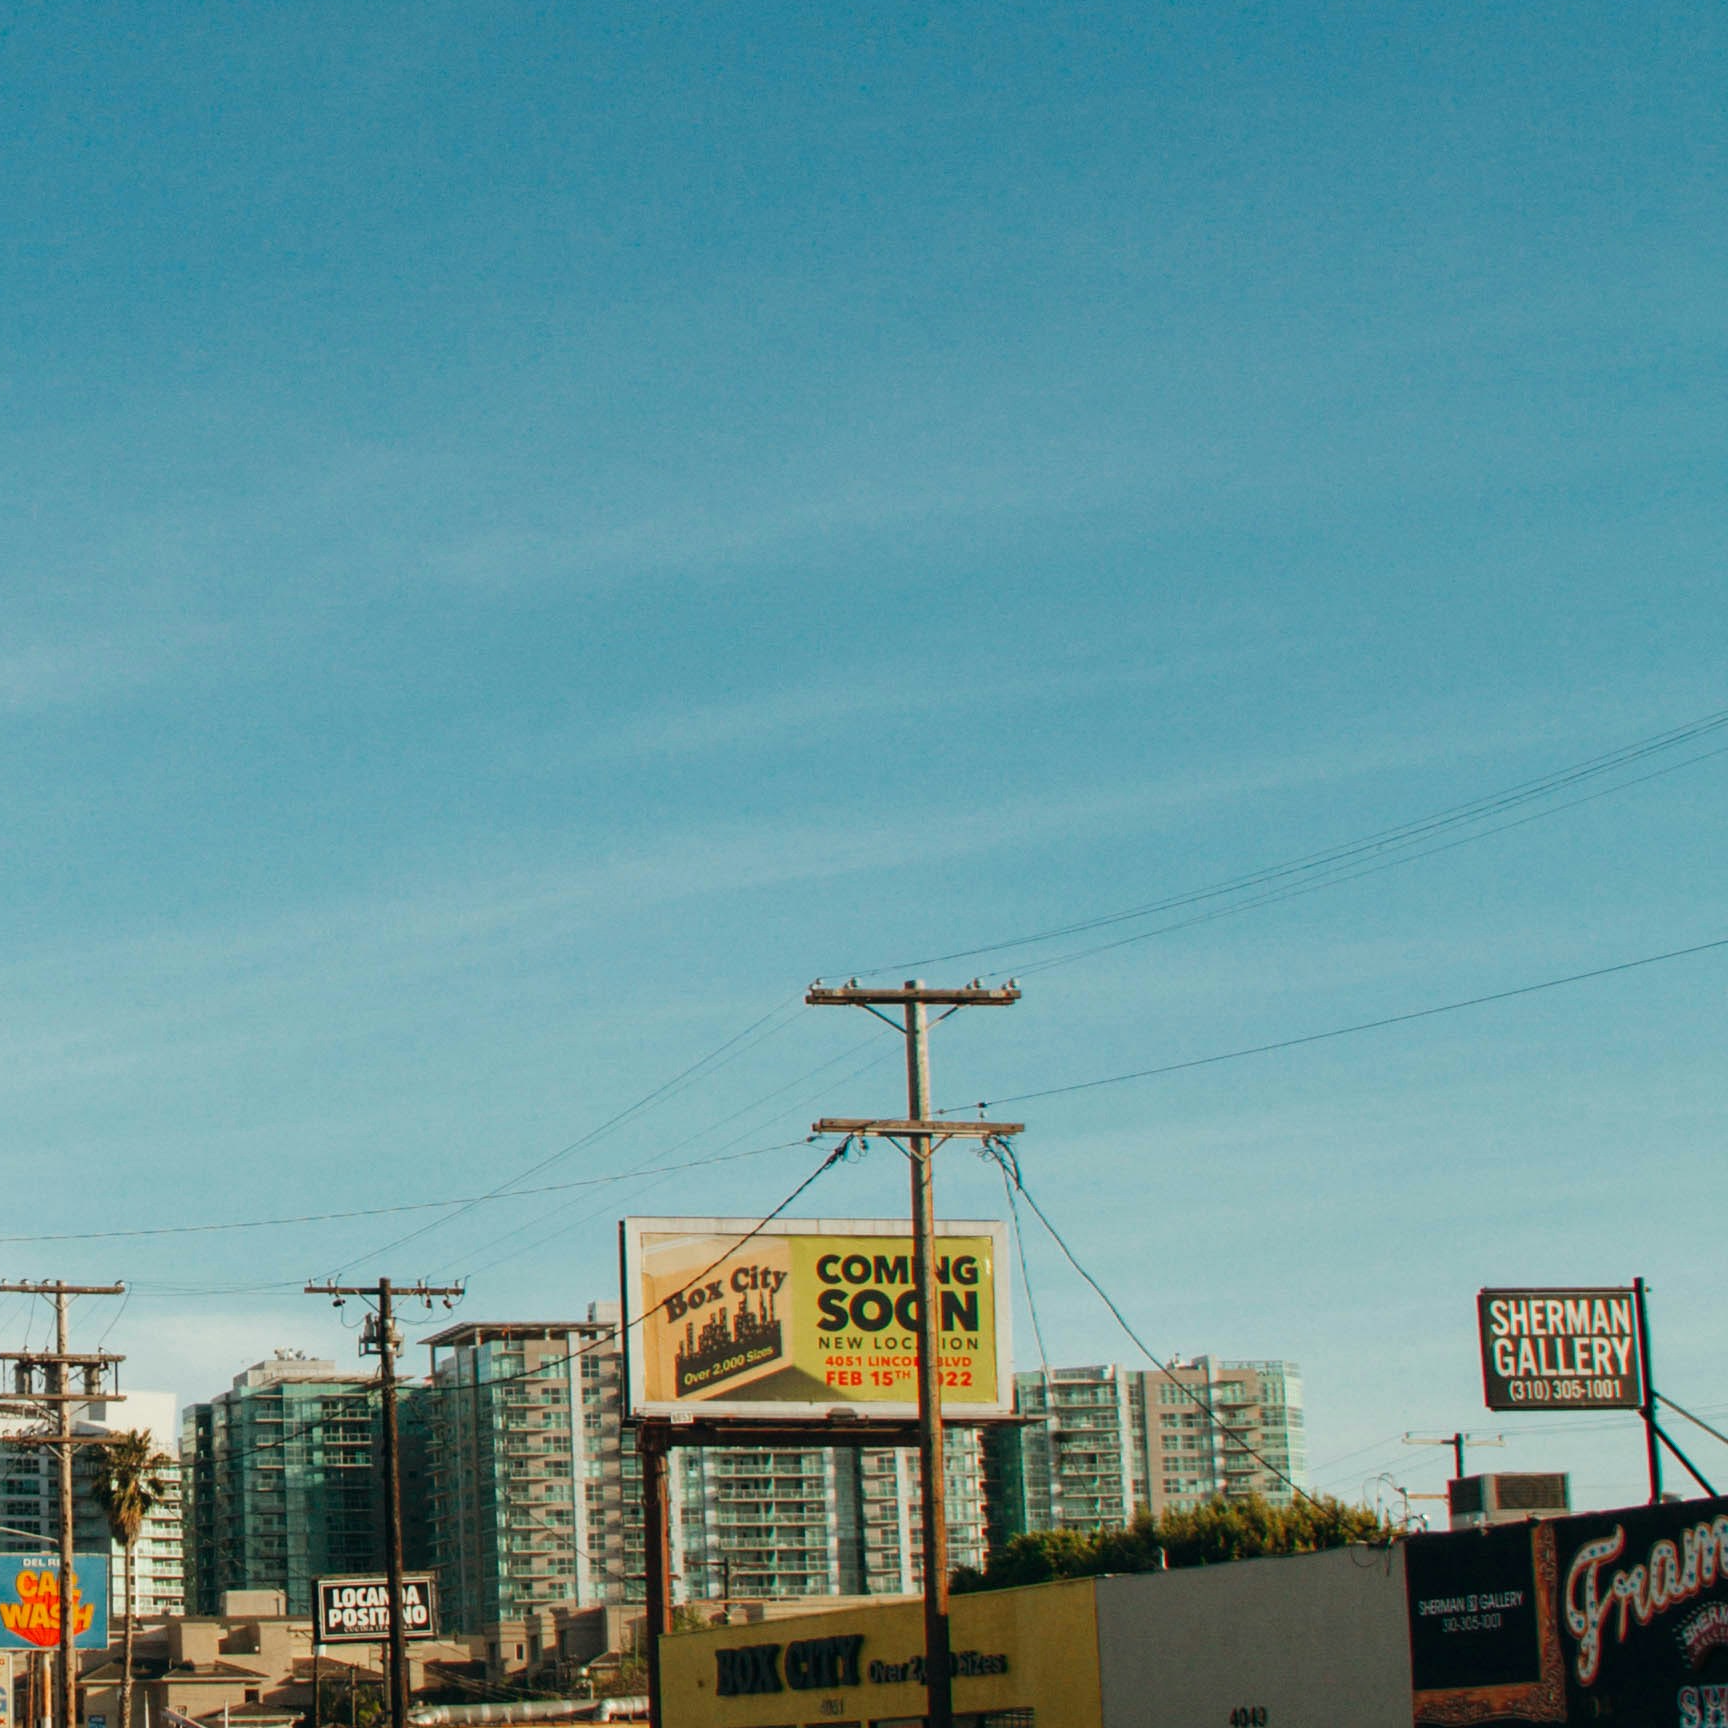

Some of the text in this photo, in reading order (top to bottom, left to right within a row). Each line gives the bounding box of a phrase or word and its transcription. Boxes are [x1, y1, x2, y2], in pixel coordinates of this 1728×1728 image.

[663, 1265, 788, 1324] Box City
[816, 1289, 979, 1332] SOON
[1490, 1299, 1632, 1336] SHERMAN
[818, 1337, 978, 1350] NEW LOCION
[684, 1345, 774, 1386] Over 2,000 Sizes
[825, 1356, 972, 1367] 4051 LINCO BLVD
[1494, 1337, 1633, 1376] GALLERY
[826, 1371, 862, 1386] FEB
[1509, 1379, 1622, 1401] (310) 305-1001
[23, 1558, 46, 1567] DEL
[333, 1585, 421, 1608] LOCANA
[1418, 1597, 1466, 1615] SHERMAN
[1479, 1591, 1524, 1610] GALLERY
[715, 1633, 865, 1696] BOX CITY
[869, 1659, 907, 1683] Over
